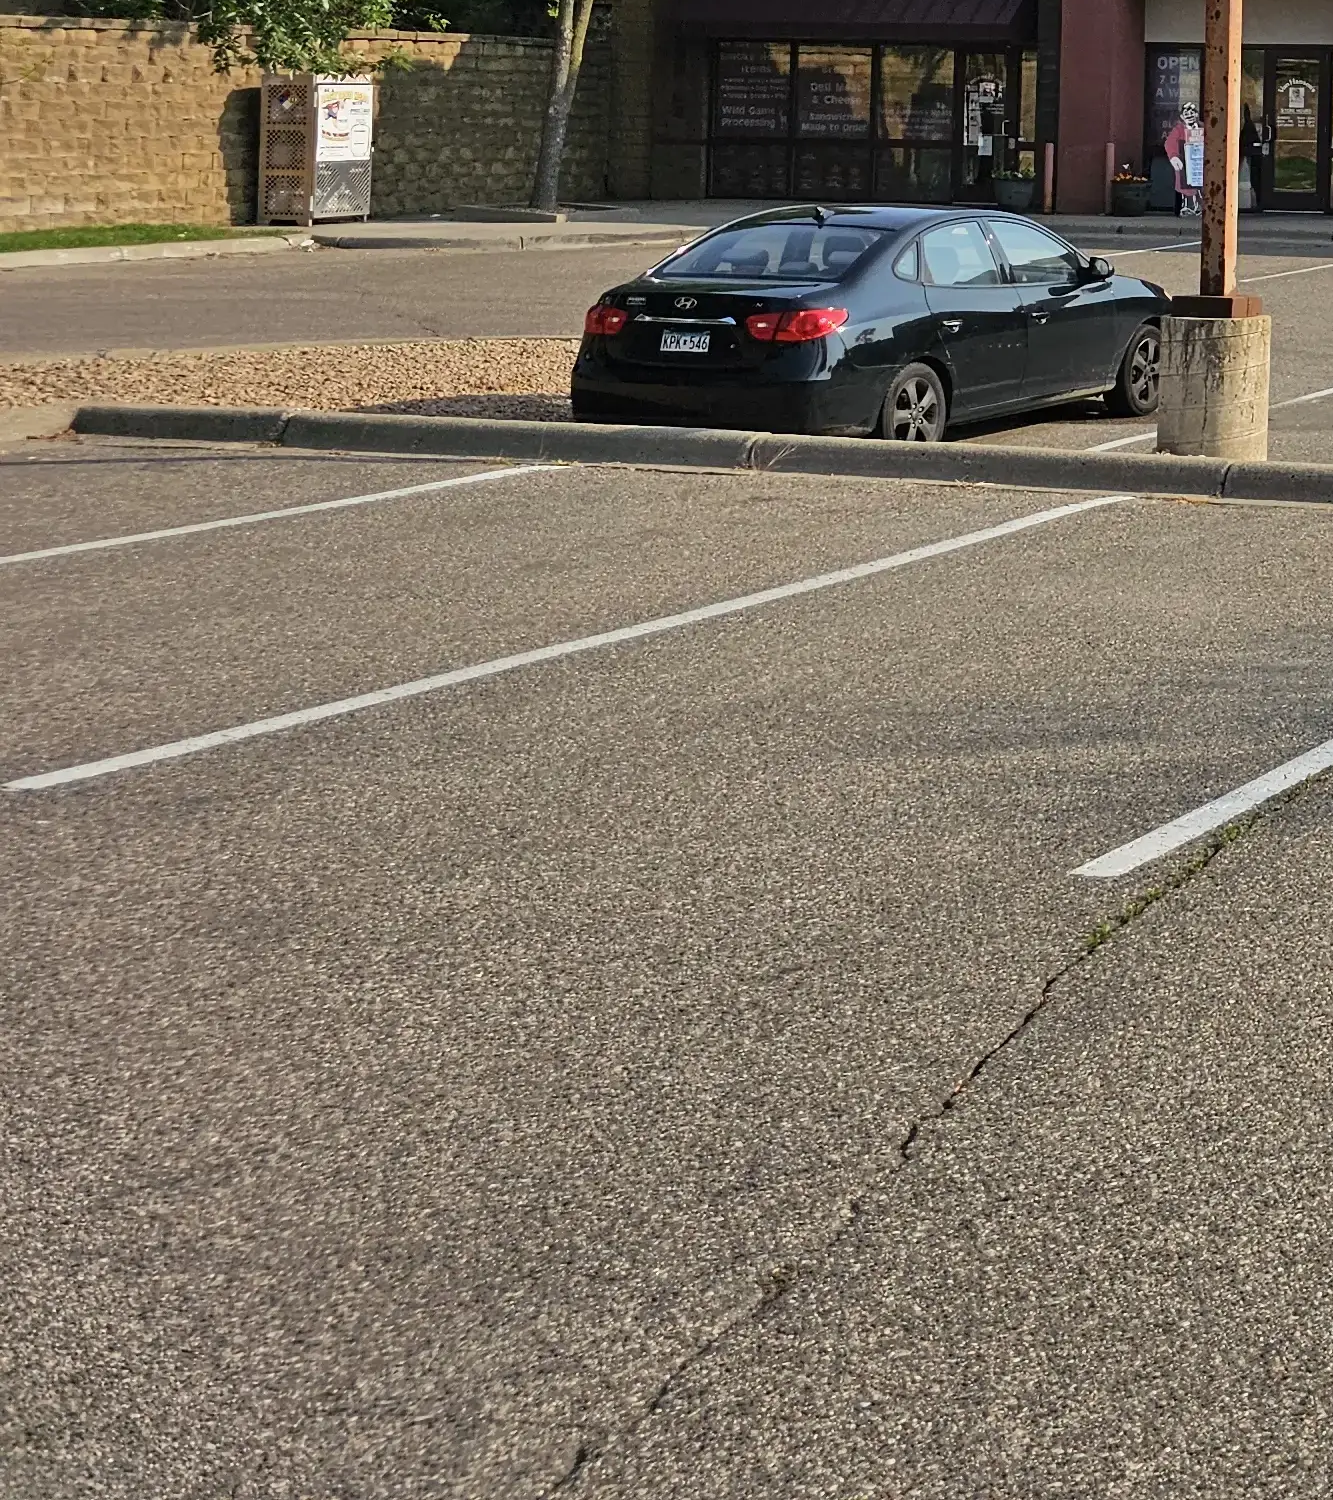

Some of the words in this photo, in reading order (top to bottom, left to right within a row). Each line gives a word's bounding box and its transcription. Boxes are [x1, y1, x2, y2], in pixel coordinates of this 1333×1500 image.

[1157, 56, 1200, 71] OPEN
[1159, 75, 1166, 85] 7
[810, 81, 832, 93] Deli
[1155, 87, 1164, 98] A
[721, 104, 746, 115] Wild
[748, 105, 776, 116] Game
[720, 117, 776, 130] Processing
[801, 122, 827, 132] Made
[830, 123, 840, 132] to
[843, 123, 868, 133] Order
[661, 334, 683, 350] KPK
[689, 335, 709, 351] 546
